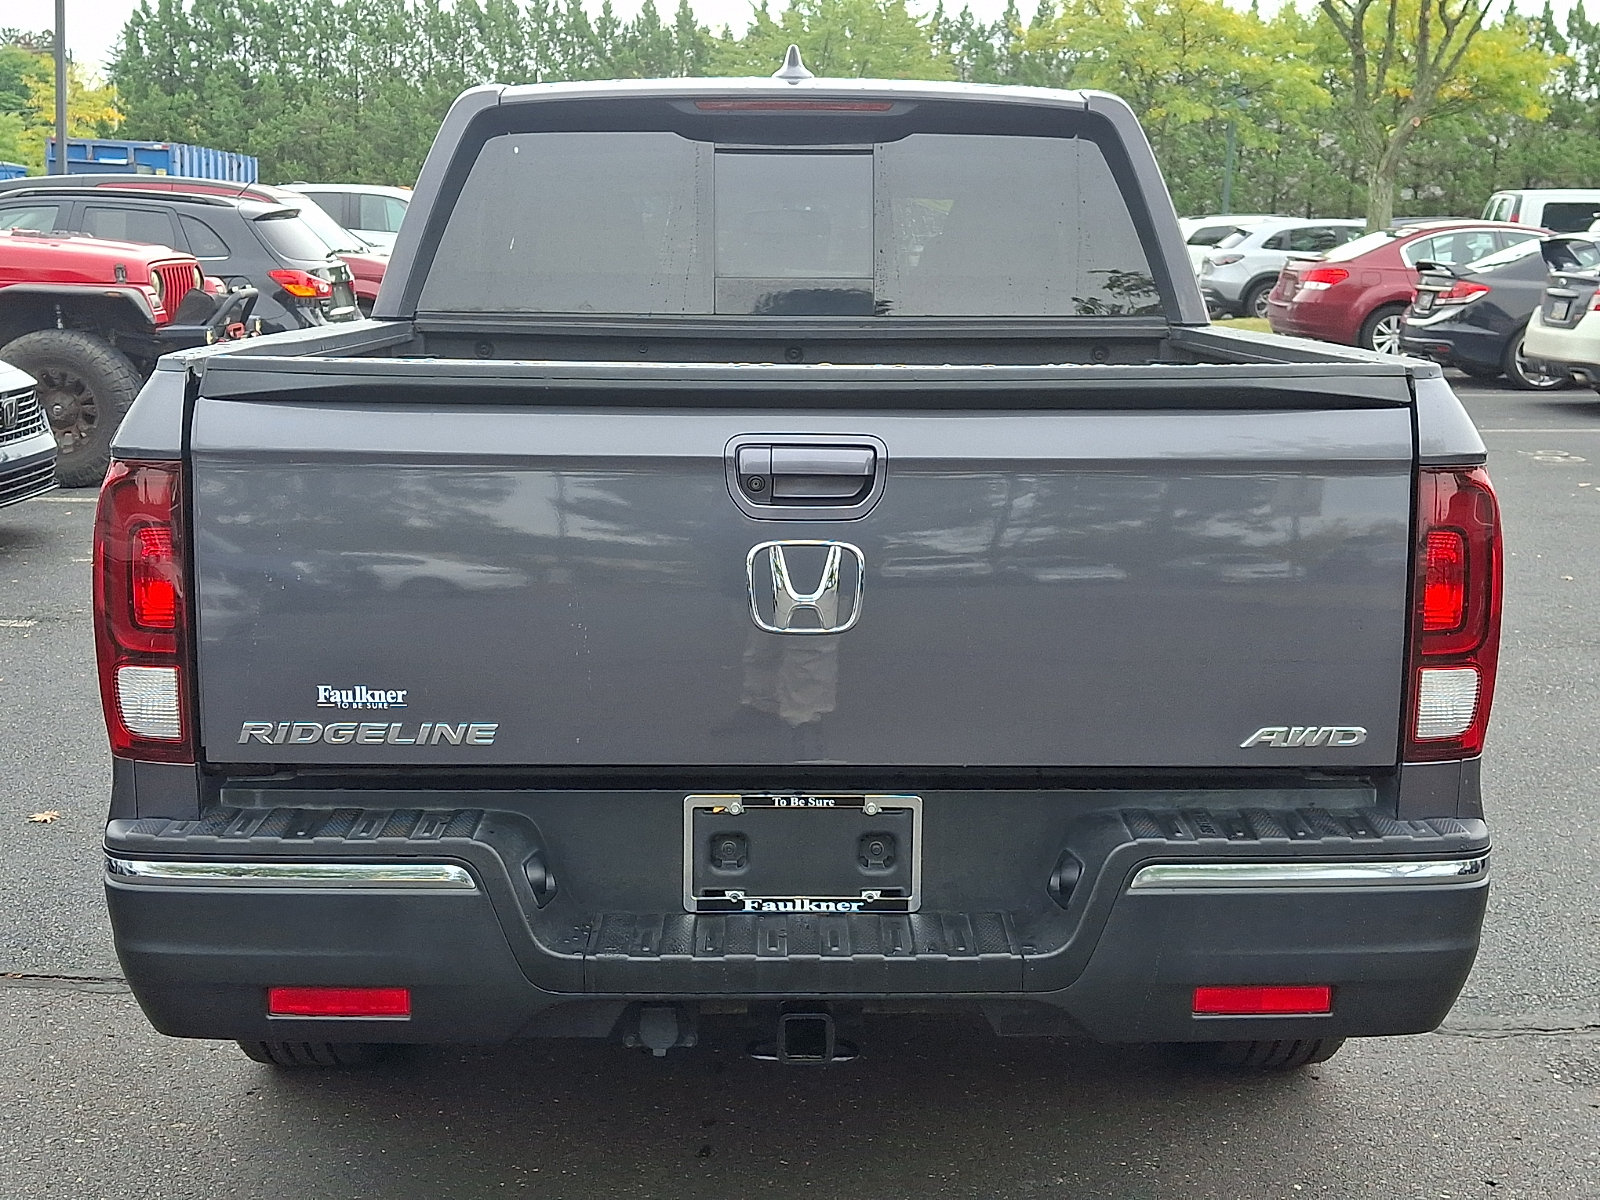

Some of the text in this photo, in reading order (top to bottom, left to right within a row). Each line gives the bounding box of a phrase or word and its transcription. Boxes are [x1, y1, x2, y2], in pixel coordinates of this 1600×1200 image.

[316, 685, 407, 703] Faulkner
[238, 721, 499, 745] RIDGELINE
[1240, 726, 1368, 748] AWD
[772, 797, 835, 807] To Be Sure
[742, 899, 864, 911] Faulkner
